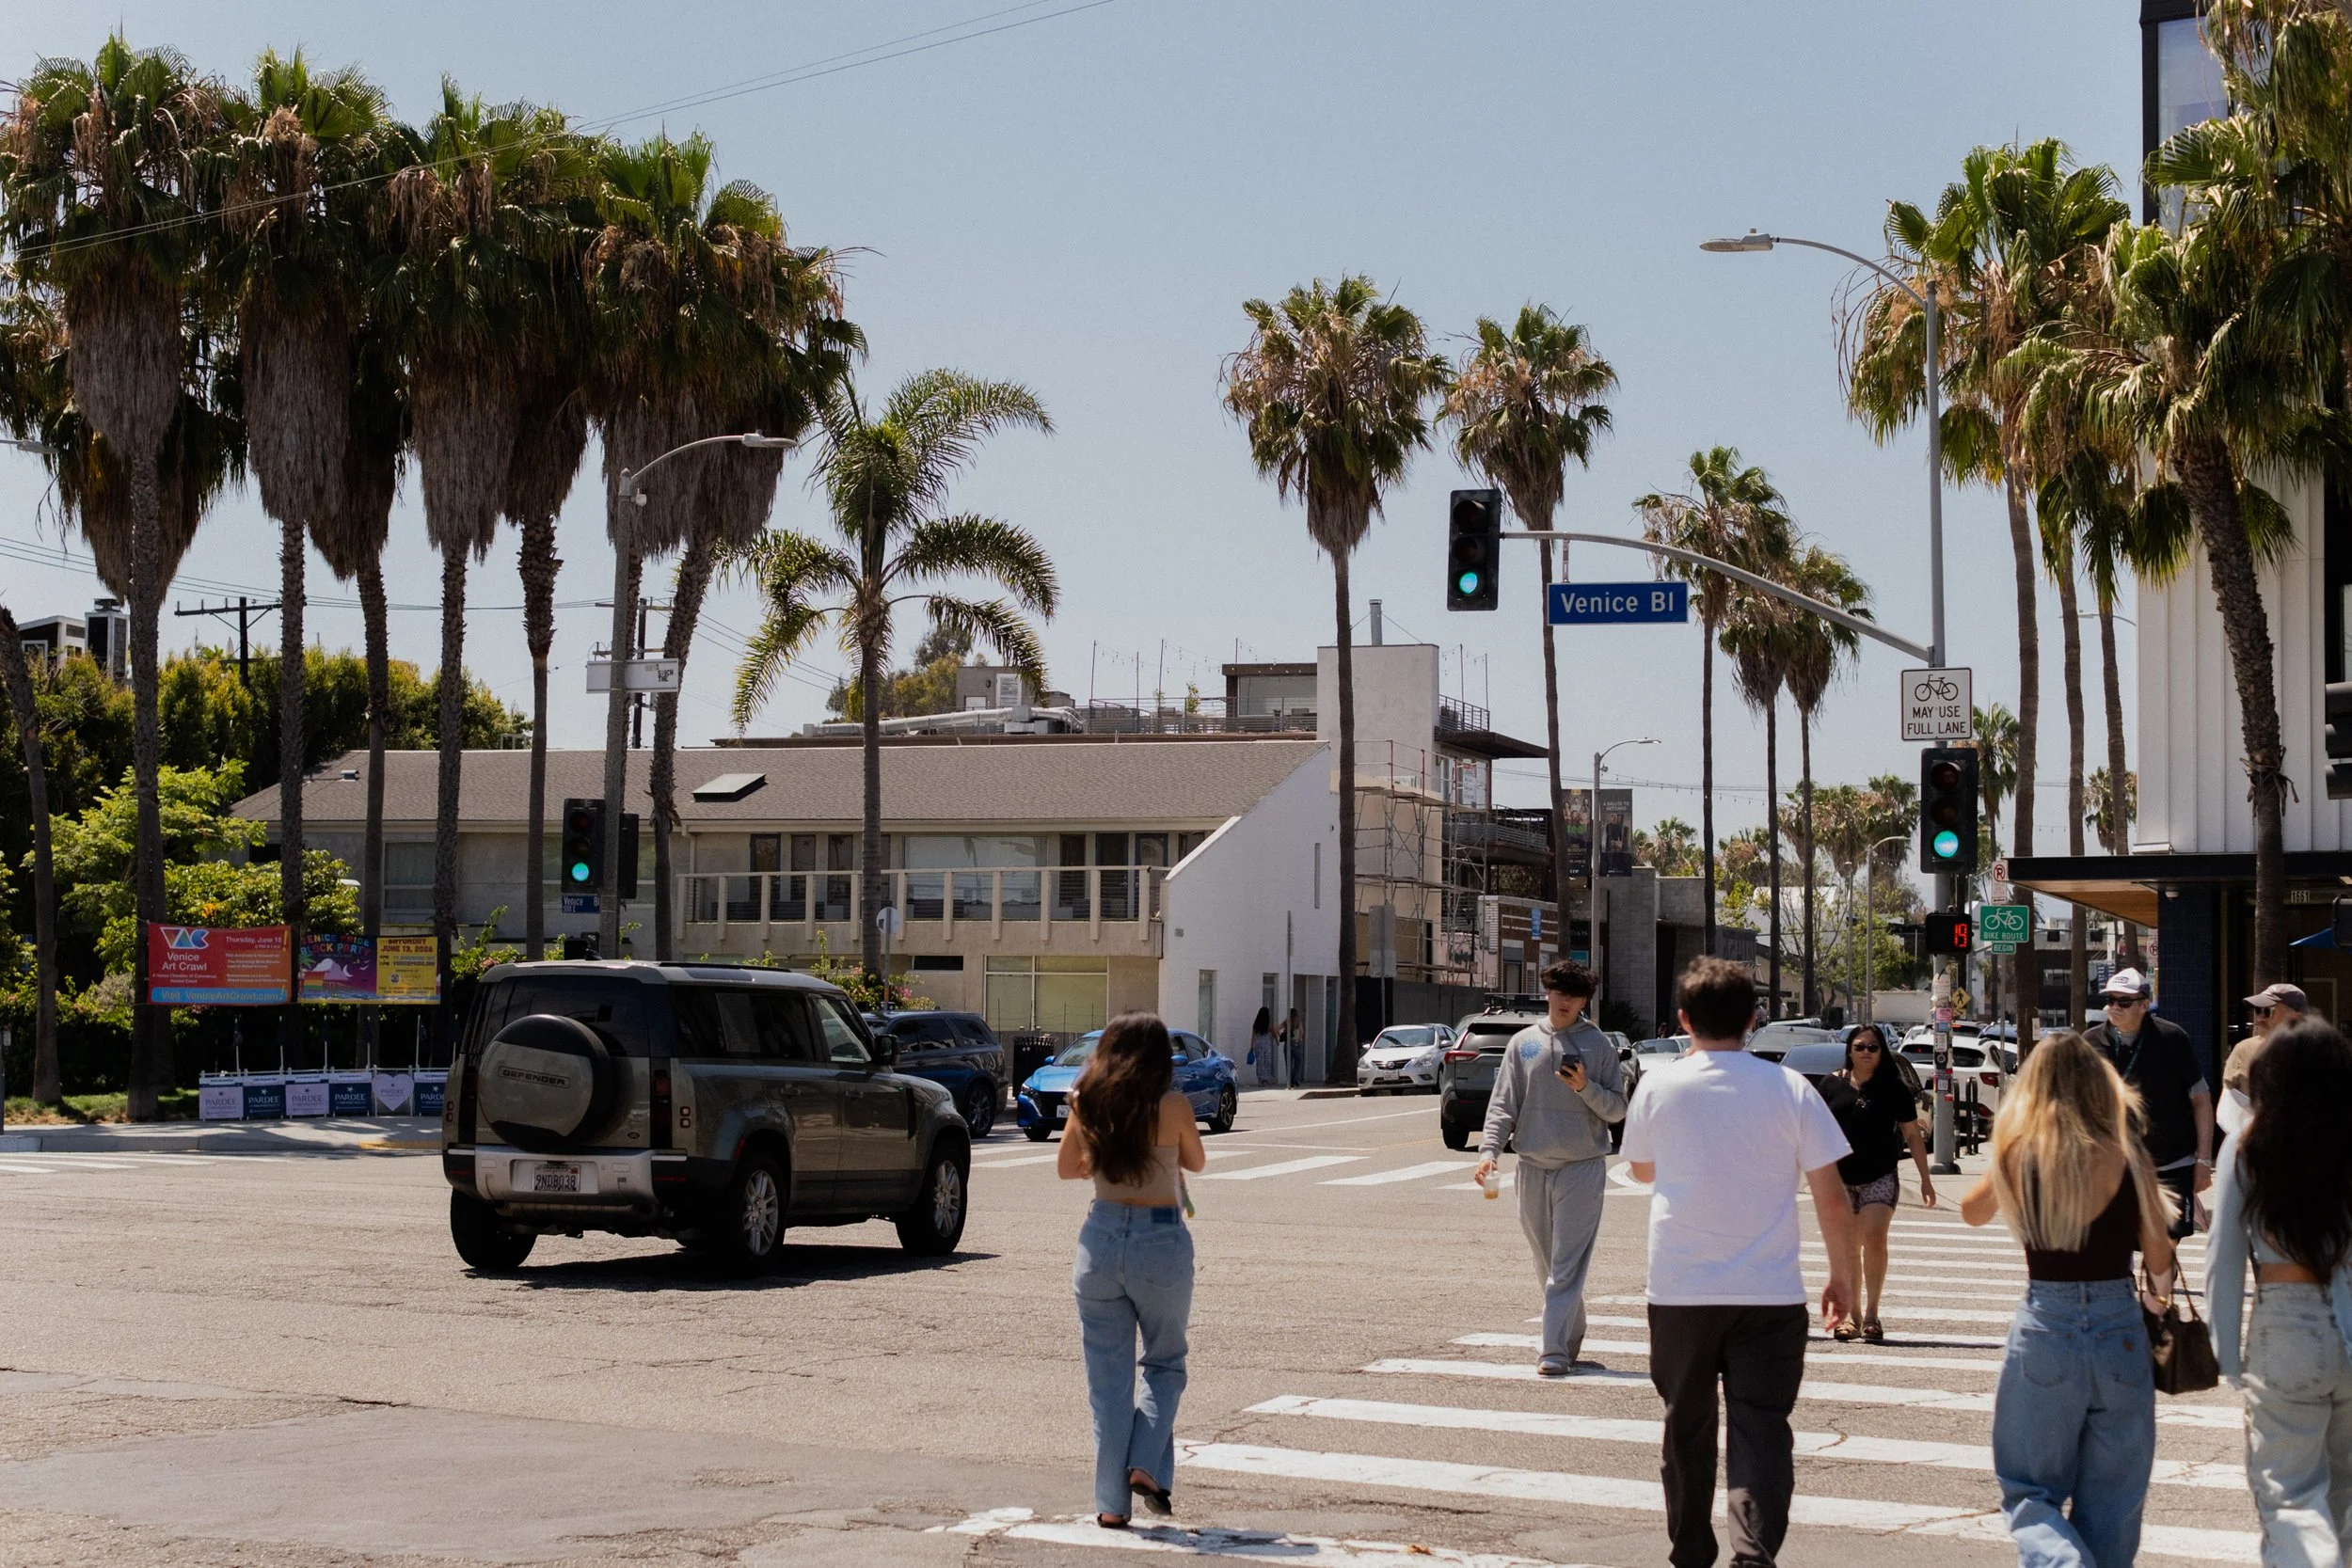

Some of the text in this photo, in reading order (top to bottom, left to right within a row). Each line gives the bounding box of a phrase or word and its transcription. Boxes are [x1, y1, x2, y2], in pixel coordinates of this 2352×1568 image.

[1561, 591, 1674, 613] Venice Bl
[1913, 705, 1961, 719] MAY USE
[1907, 721, 1966, 735] FULL LANE
[564, 895, 584, 906] Venice
[258, 936, 273, 944] June
[1954, 923, 1967, 947] 19
[1983, 931, 2024, 941] BIKE ROUTE
[340, 934, 371, 947] PRIDE
[300, 942, 371, 957] BLOCK PARTY
[1993, 943, 2013, 952] BEGIN
[167, 952, 199, 961] Venice
[162, 962, 207, 971] Art Crawl
[161, 990, 181, 1000] Visit
[502, 1069, 565, 1085] DEFENDER
[205, 1098, 235, 1106] PARDEE
[248, 1096, 279, 1104] PARDEE
